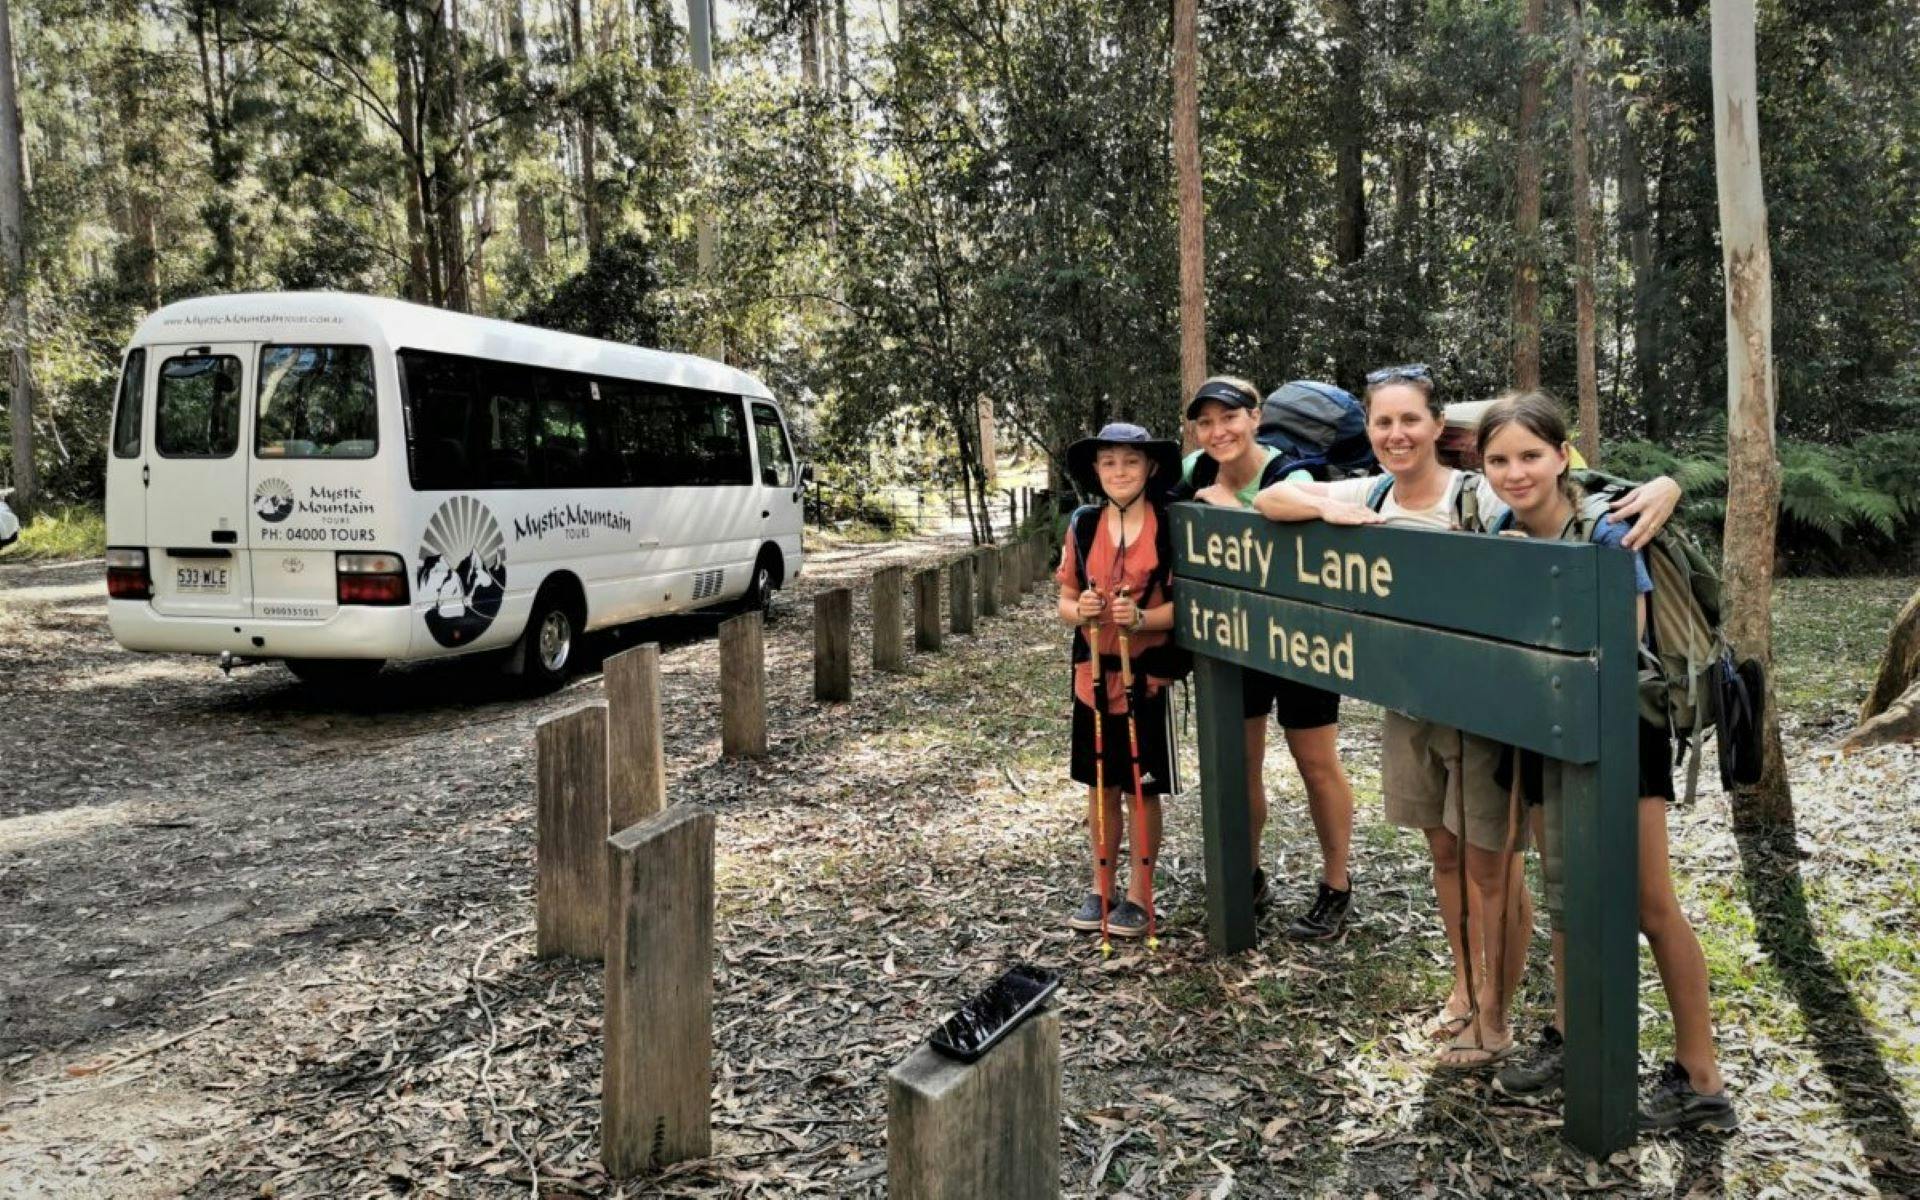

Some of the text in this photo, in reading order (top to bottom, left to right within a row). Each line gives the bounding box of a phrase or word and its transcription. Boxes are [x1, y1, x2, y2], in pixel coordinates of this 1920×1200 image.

[310, 486, 361, 501] Mystic
[298, 500, 374, 514] Mountain
[261, 528, 376, 541] PH: 04000 TOURS
[565, 527, 590, 539] TOURS
[1185, 521, 1393, 597] Leafy Lane
[178, 568, 227, 585] 533 WLE
[1190, 599, 1354, 681] trail head
